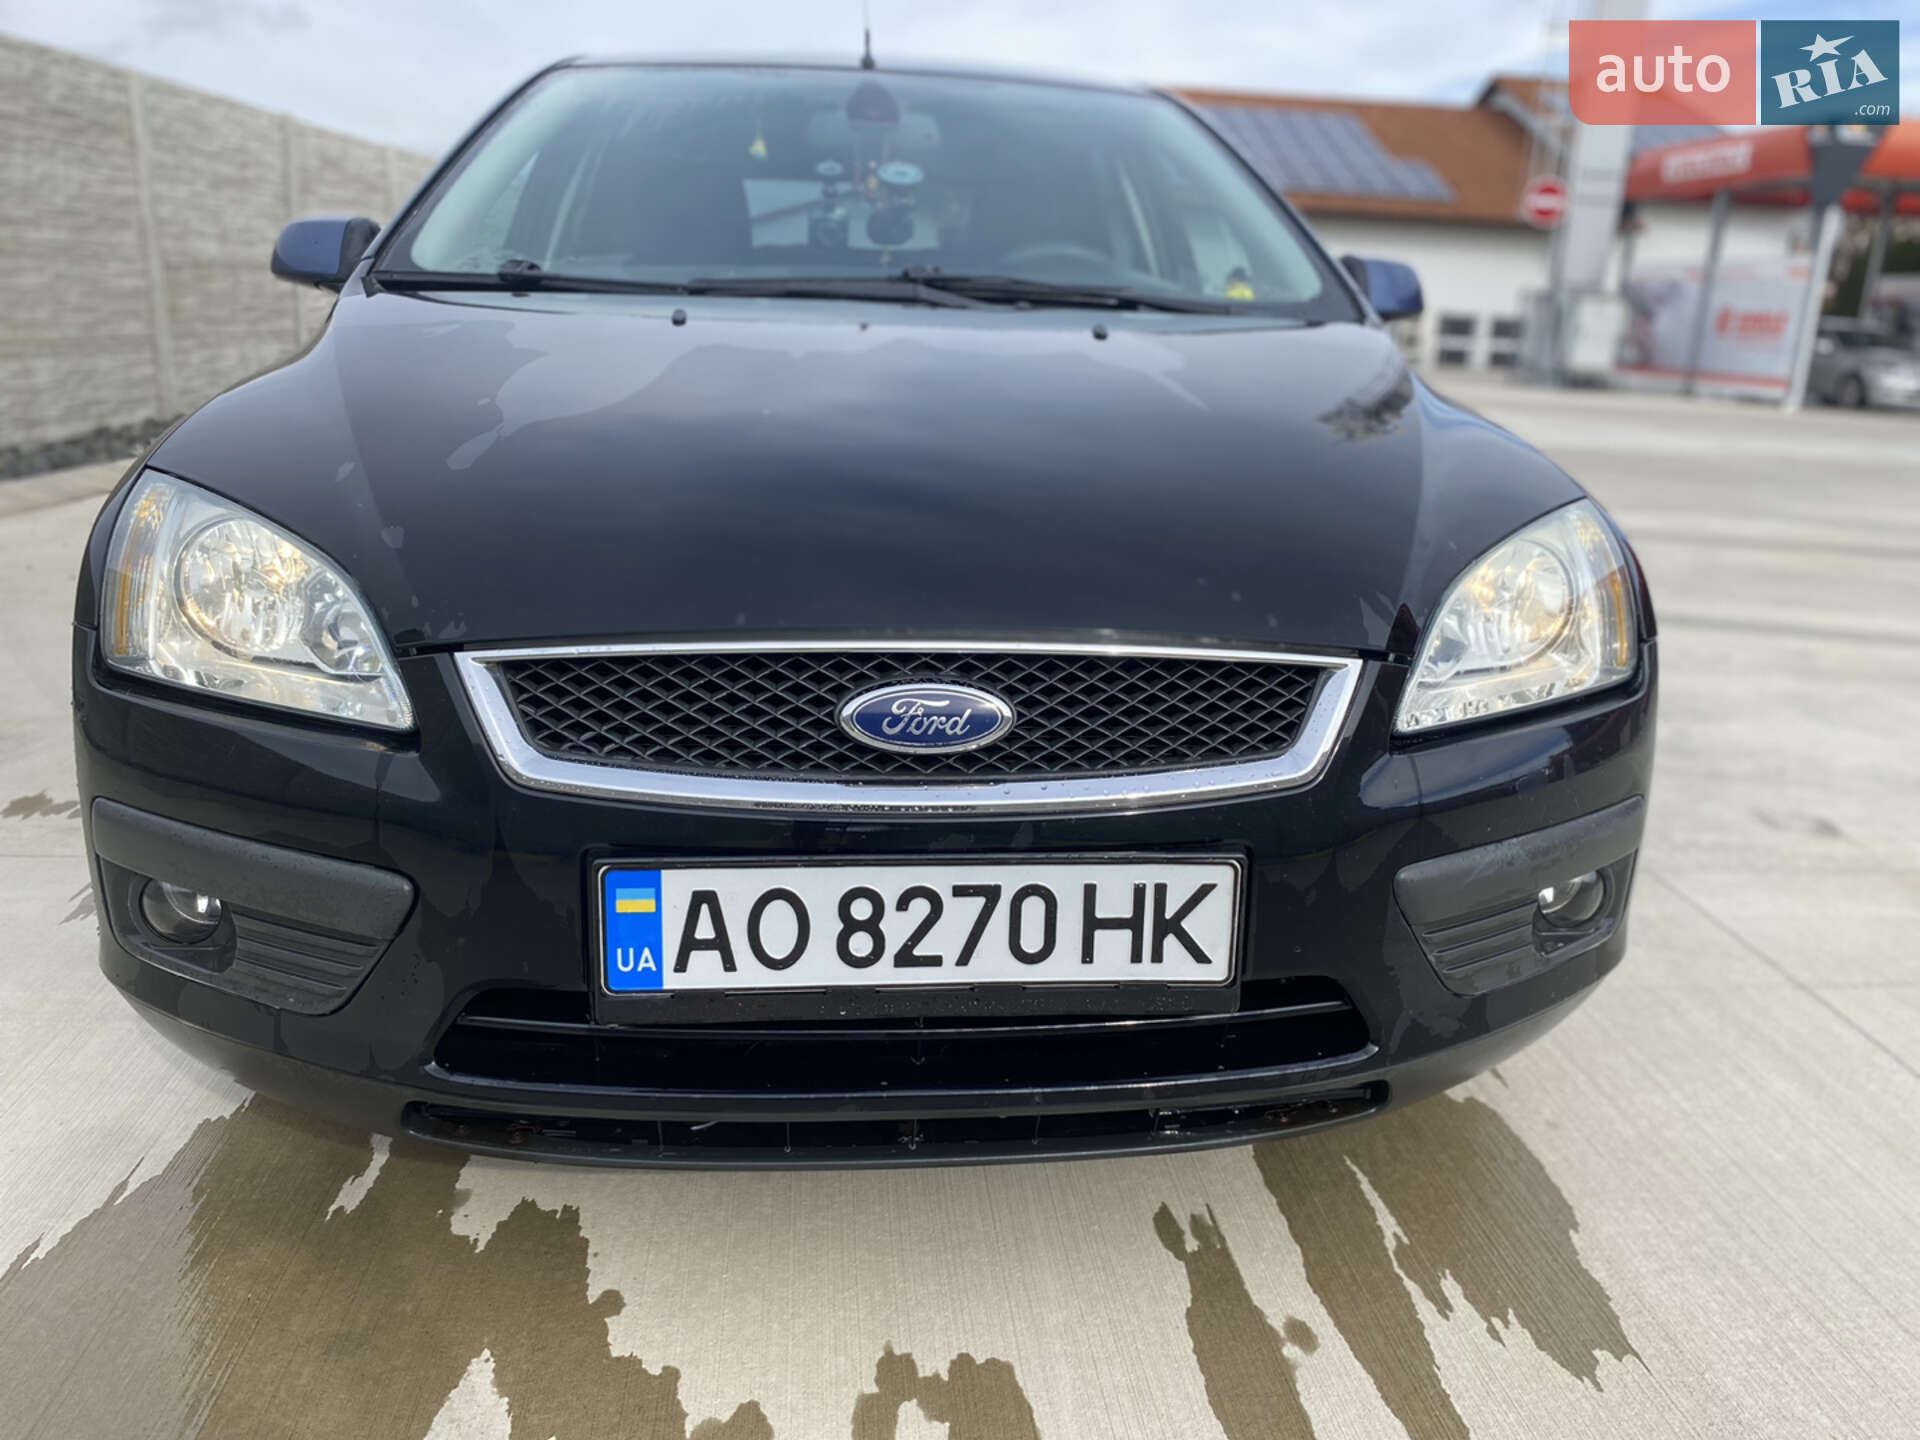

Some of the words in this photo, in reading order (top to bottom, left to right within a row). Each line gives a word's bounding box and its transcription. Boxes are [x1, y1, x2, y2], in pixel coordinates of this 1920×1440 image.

[881, 698, 973, 736] Ford
[673, 887, 811, 973] AO
[836, 881, 1058, 969] 8270
[1081, 882, 1219, 965] HK
[615, 947, 657, 973] UA
